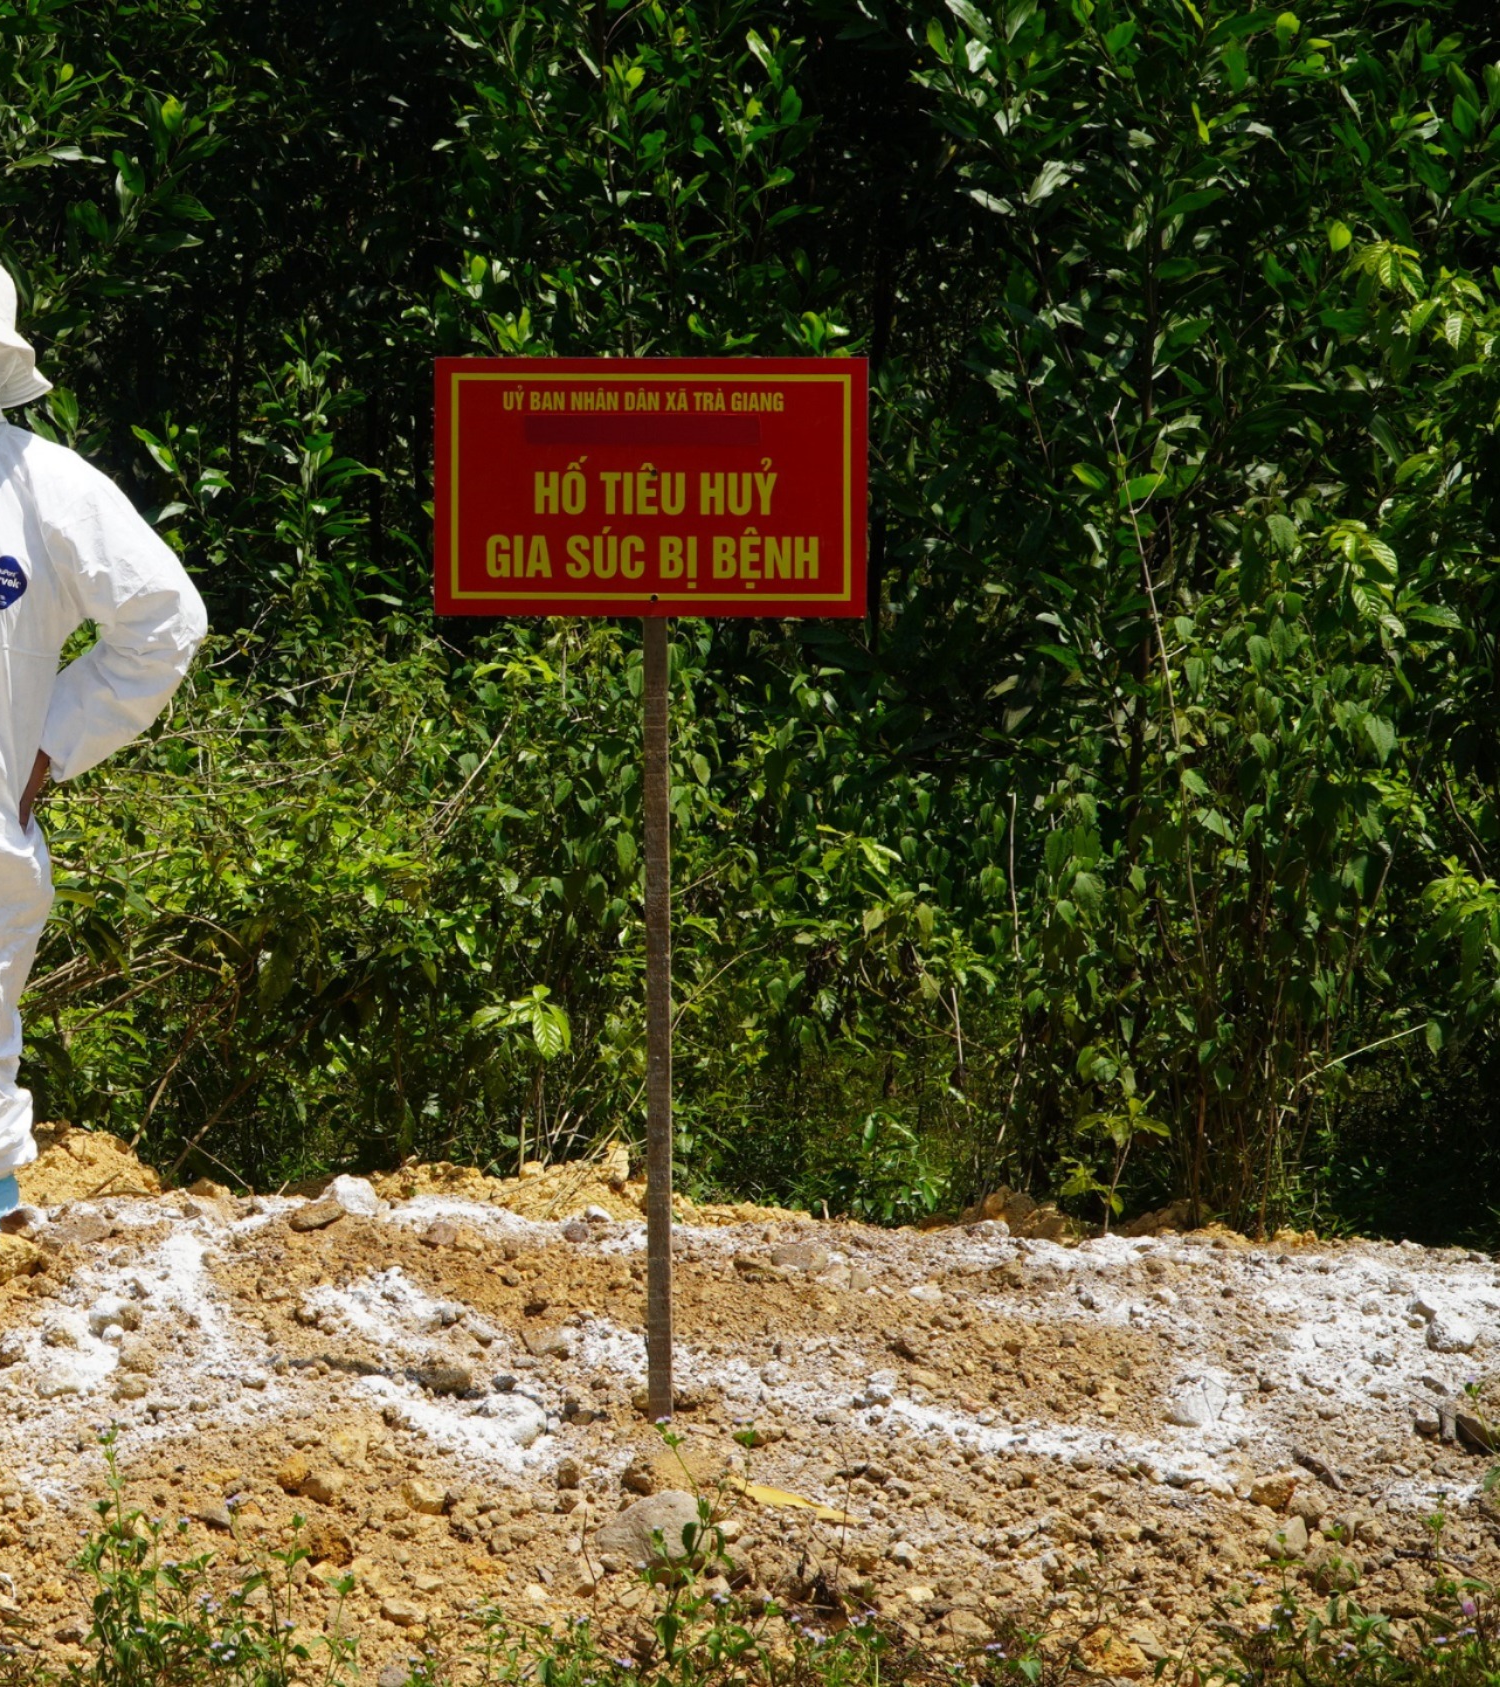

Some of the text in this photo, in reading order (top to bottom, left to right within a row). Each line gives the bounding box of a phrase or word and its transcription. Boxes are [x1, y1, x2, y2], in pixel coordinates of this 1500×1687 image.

[503, 385, 784, 412] UỶ BAN NHÂN DÂN XÃ TRÀ GIANG
[534, 456, 778, 515] HỐ TIÊU HUỶ
[486, 526, 819, 589] GIA SÚC BỊ BỆNH
